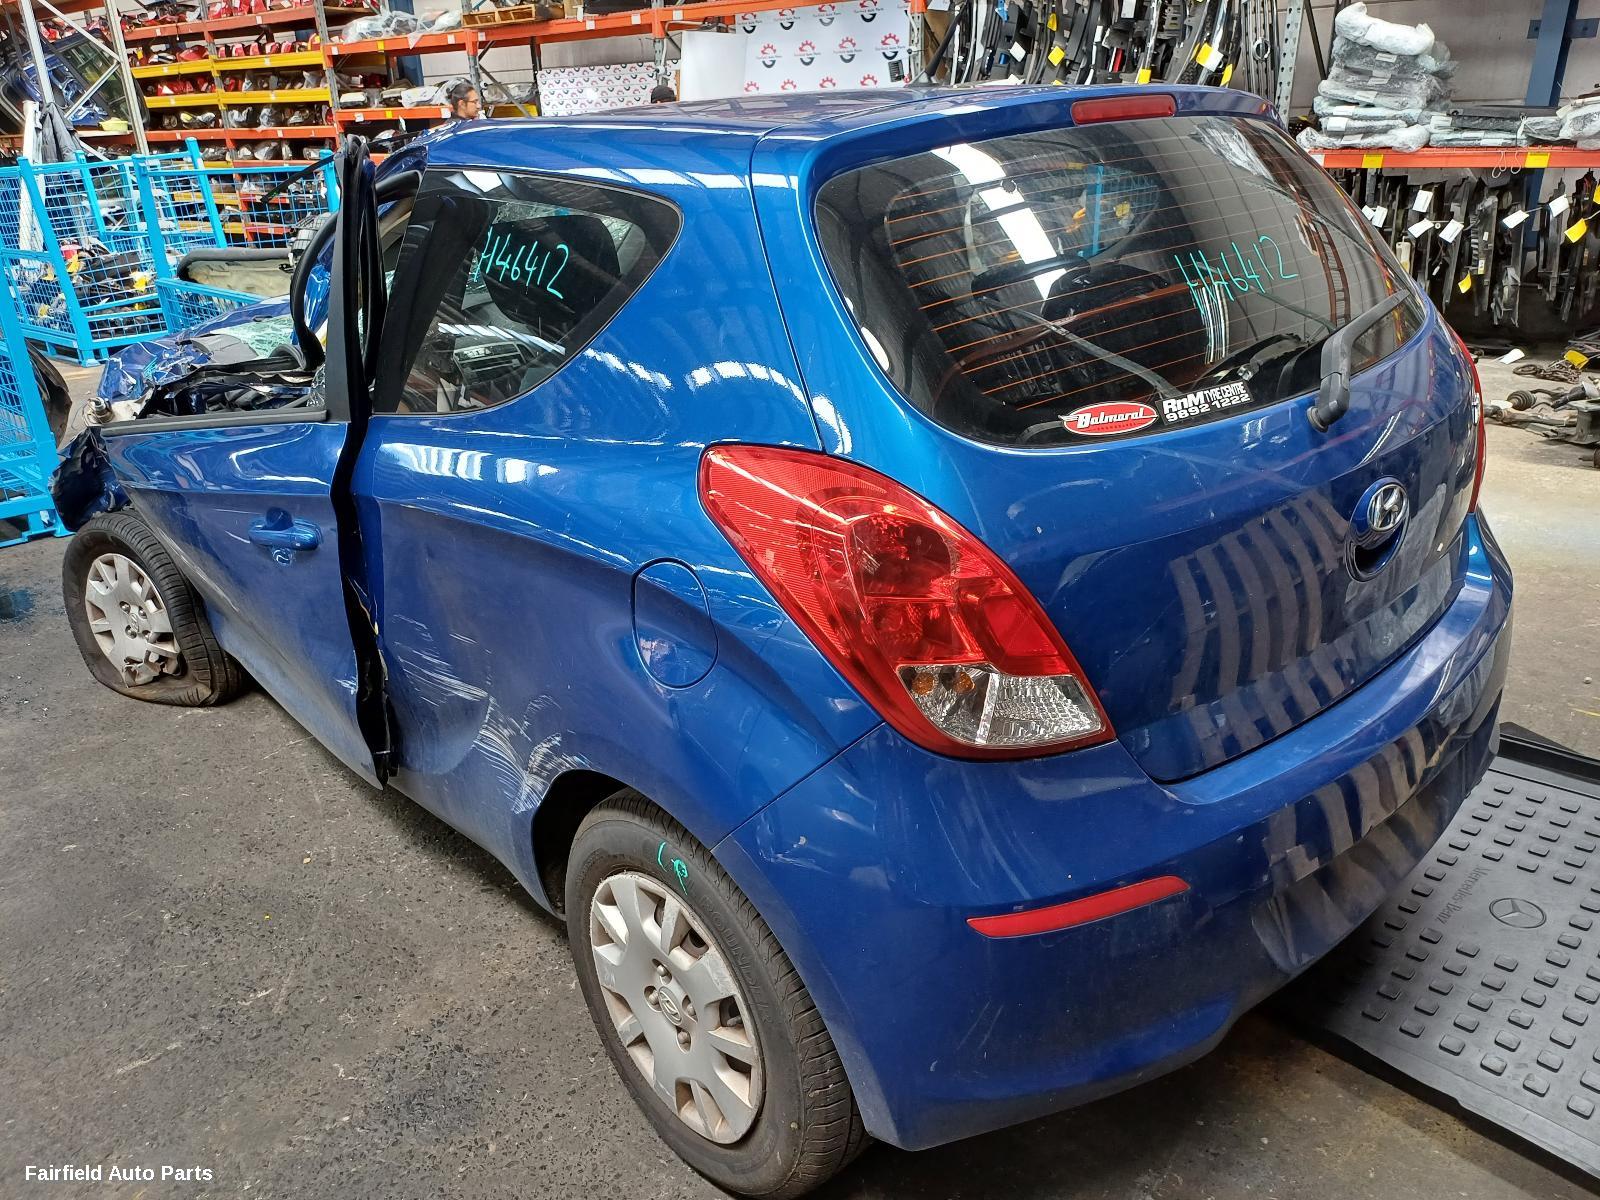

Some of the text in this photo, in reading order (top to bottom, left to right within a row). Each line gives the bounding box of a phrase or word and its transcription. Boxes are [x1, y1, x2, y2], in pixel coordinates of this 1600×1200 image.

[1162, 381, 1247, 415] RnM TYRE CENTRE
[1165, 393, 1251, 422] 9892 1222
